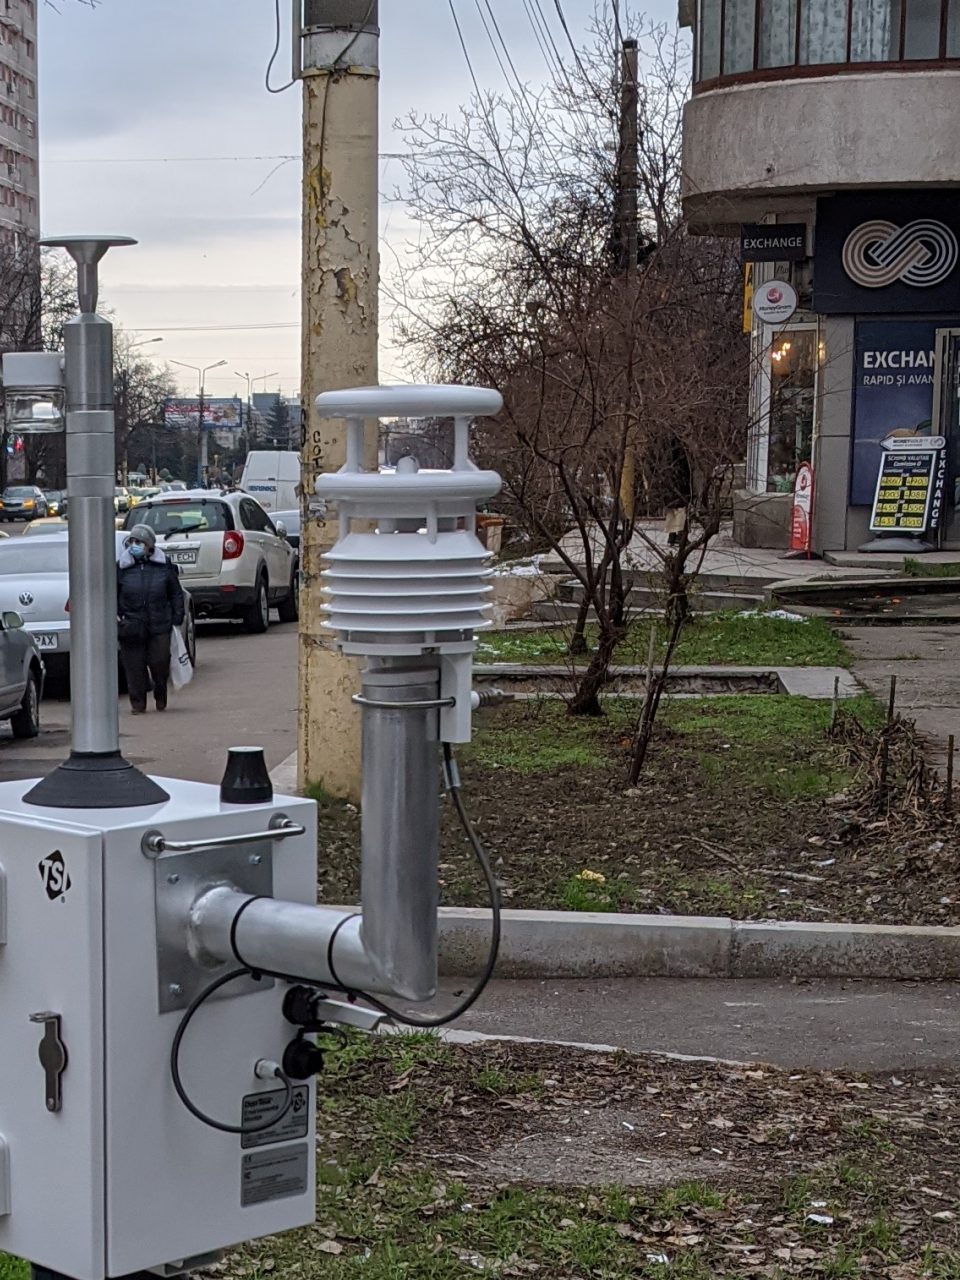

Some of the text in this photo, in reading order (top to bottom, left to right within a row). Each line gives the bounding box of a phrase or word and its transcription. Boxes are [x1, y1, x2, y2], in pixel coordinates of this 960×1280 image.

[743, 236, 803, 249] EXCHANGE
[863, 375, 894, 386] RAPID
[930, 449, 947, 528] EXCHANGE
[177, 552, 195, 561] ECH
